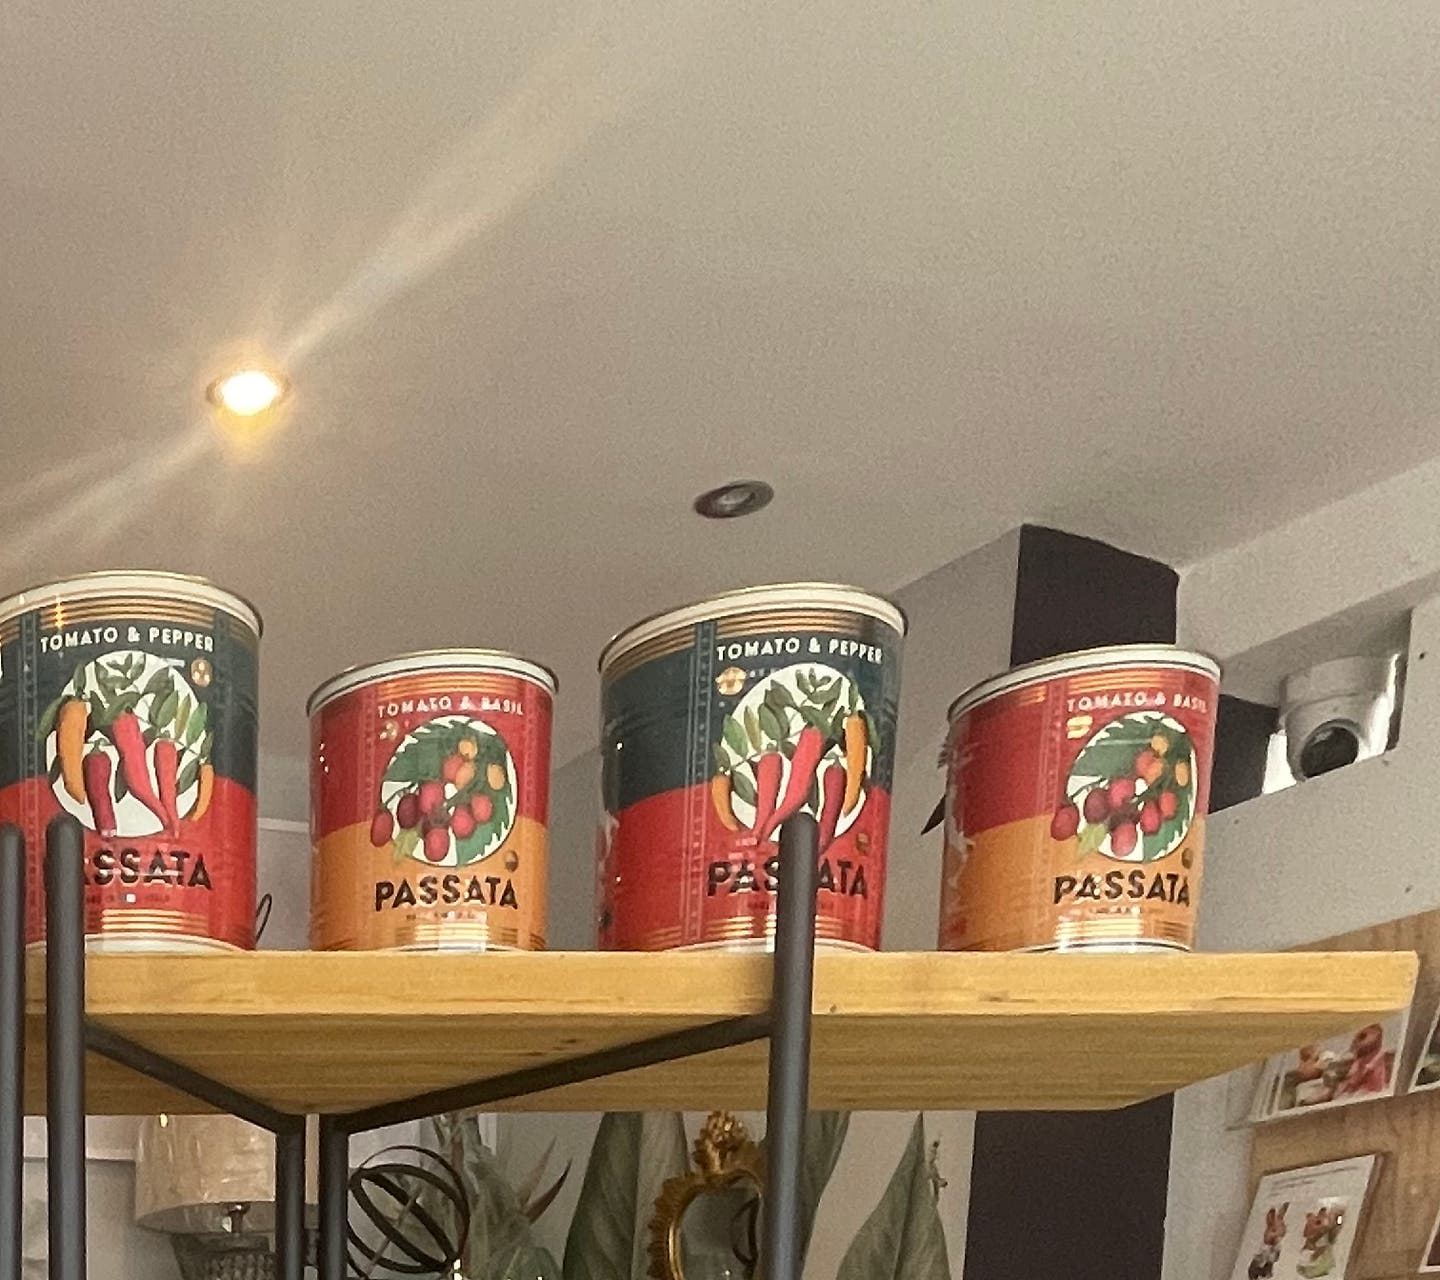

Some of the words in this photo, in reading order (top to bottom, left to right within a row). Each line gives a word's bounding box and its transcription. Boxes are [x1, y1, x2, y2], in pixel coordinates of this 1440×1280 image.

[40, 627, 119, 653] TOMATO
[127, 627, 141, 644] &
[148, 627, 215, 653] PEPPER
[716, 637, 800, 662] TOMATO
[808, 636, 822, 655] &
[828, 637, 883, 664] PEPPER
[377, 697, 451, 718] TOMATO
[481, 698, 524, 717] BASIL
[1067, 694, 1147, 713] TOMATO
[84, 848, 213, 891] SSATA
[707, 856, 868, 899] PASATA
[374, 875, 520, 913] PASSATA
[1053, 870, 1191, 907] PASSATA
